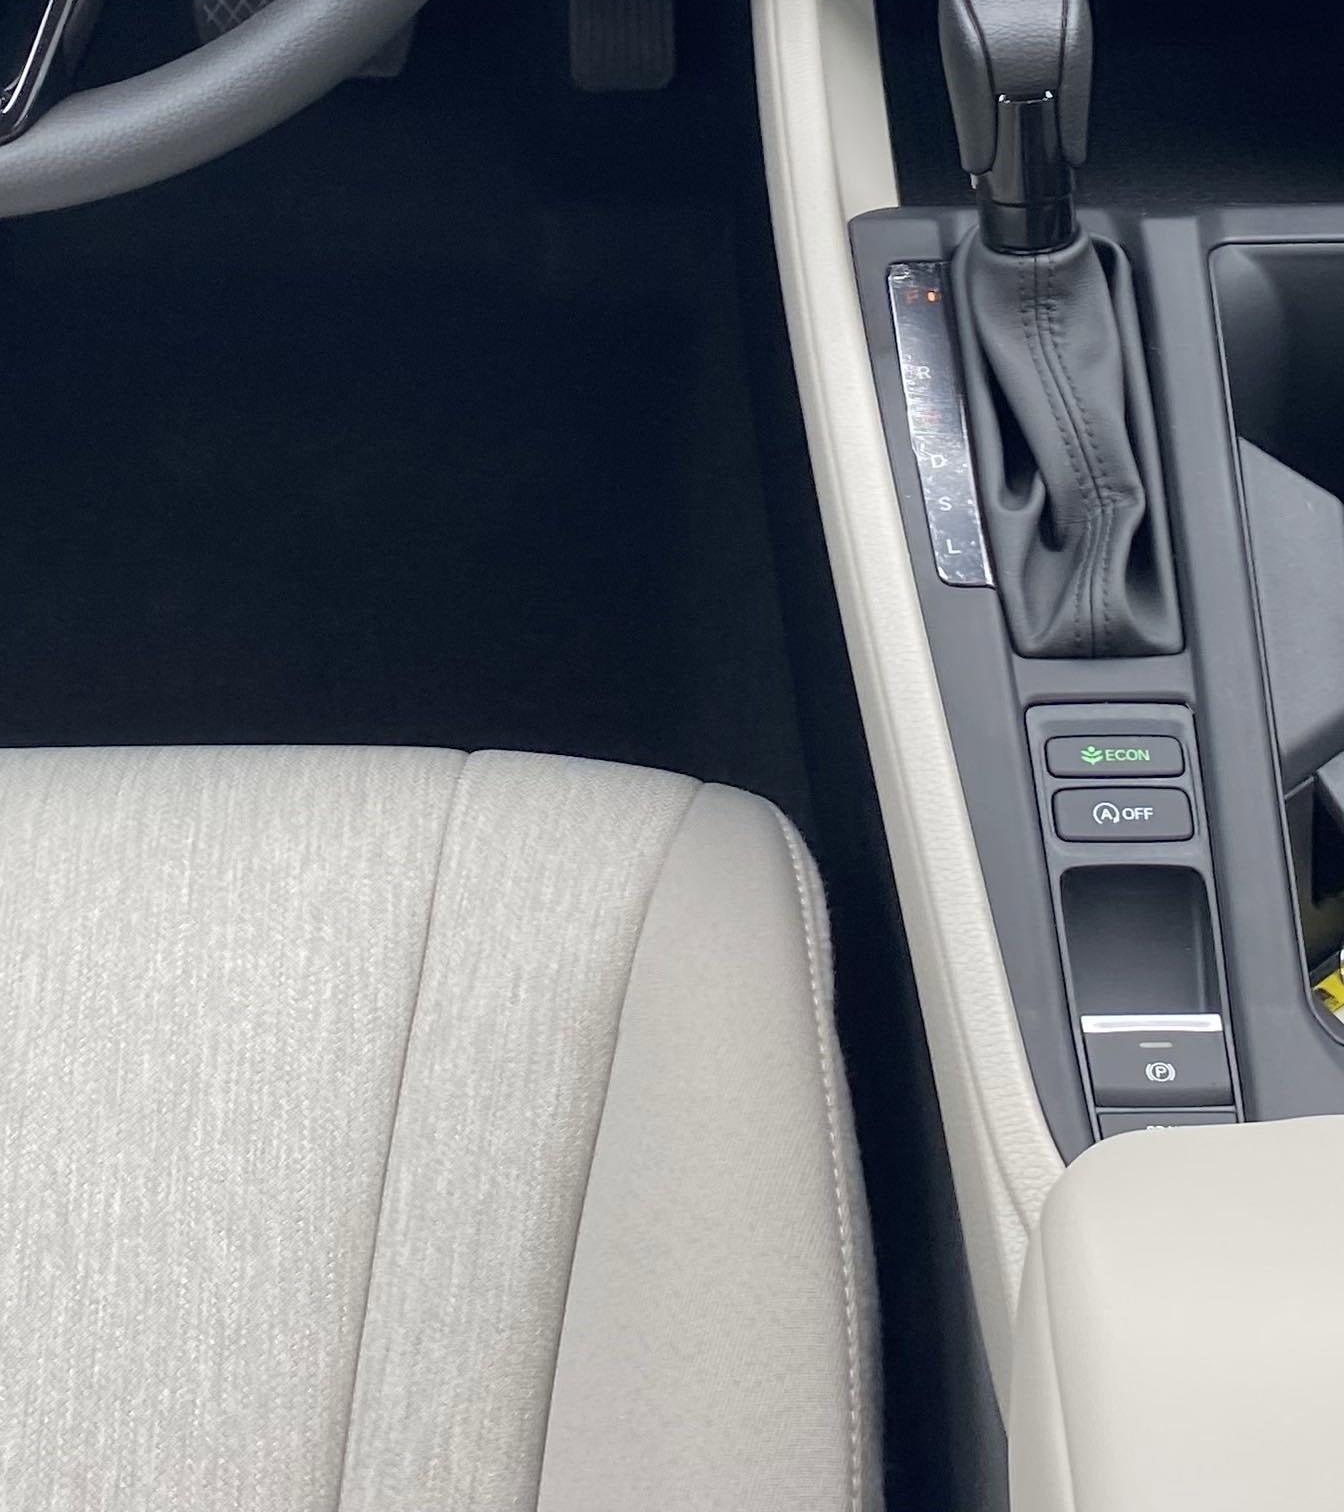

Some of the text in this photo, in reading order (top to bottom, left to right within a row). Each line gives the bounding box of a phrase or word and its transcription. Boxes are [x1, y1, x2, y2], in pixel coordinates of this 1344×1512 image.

[939, 496, 953, 512] S
[946, 538, 962, 555] L
[1105, 748, 1151, 762] ECON
[1121, 807, 1154, 821] OFF
